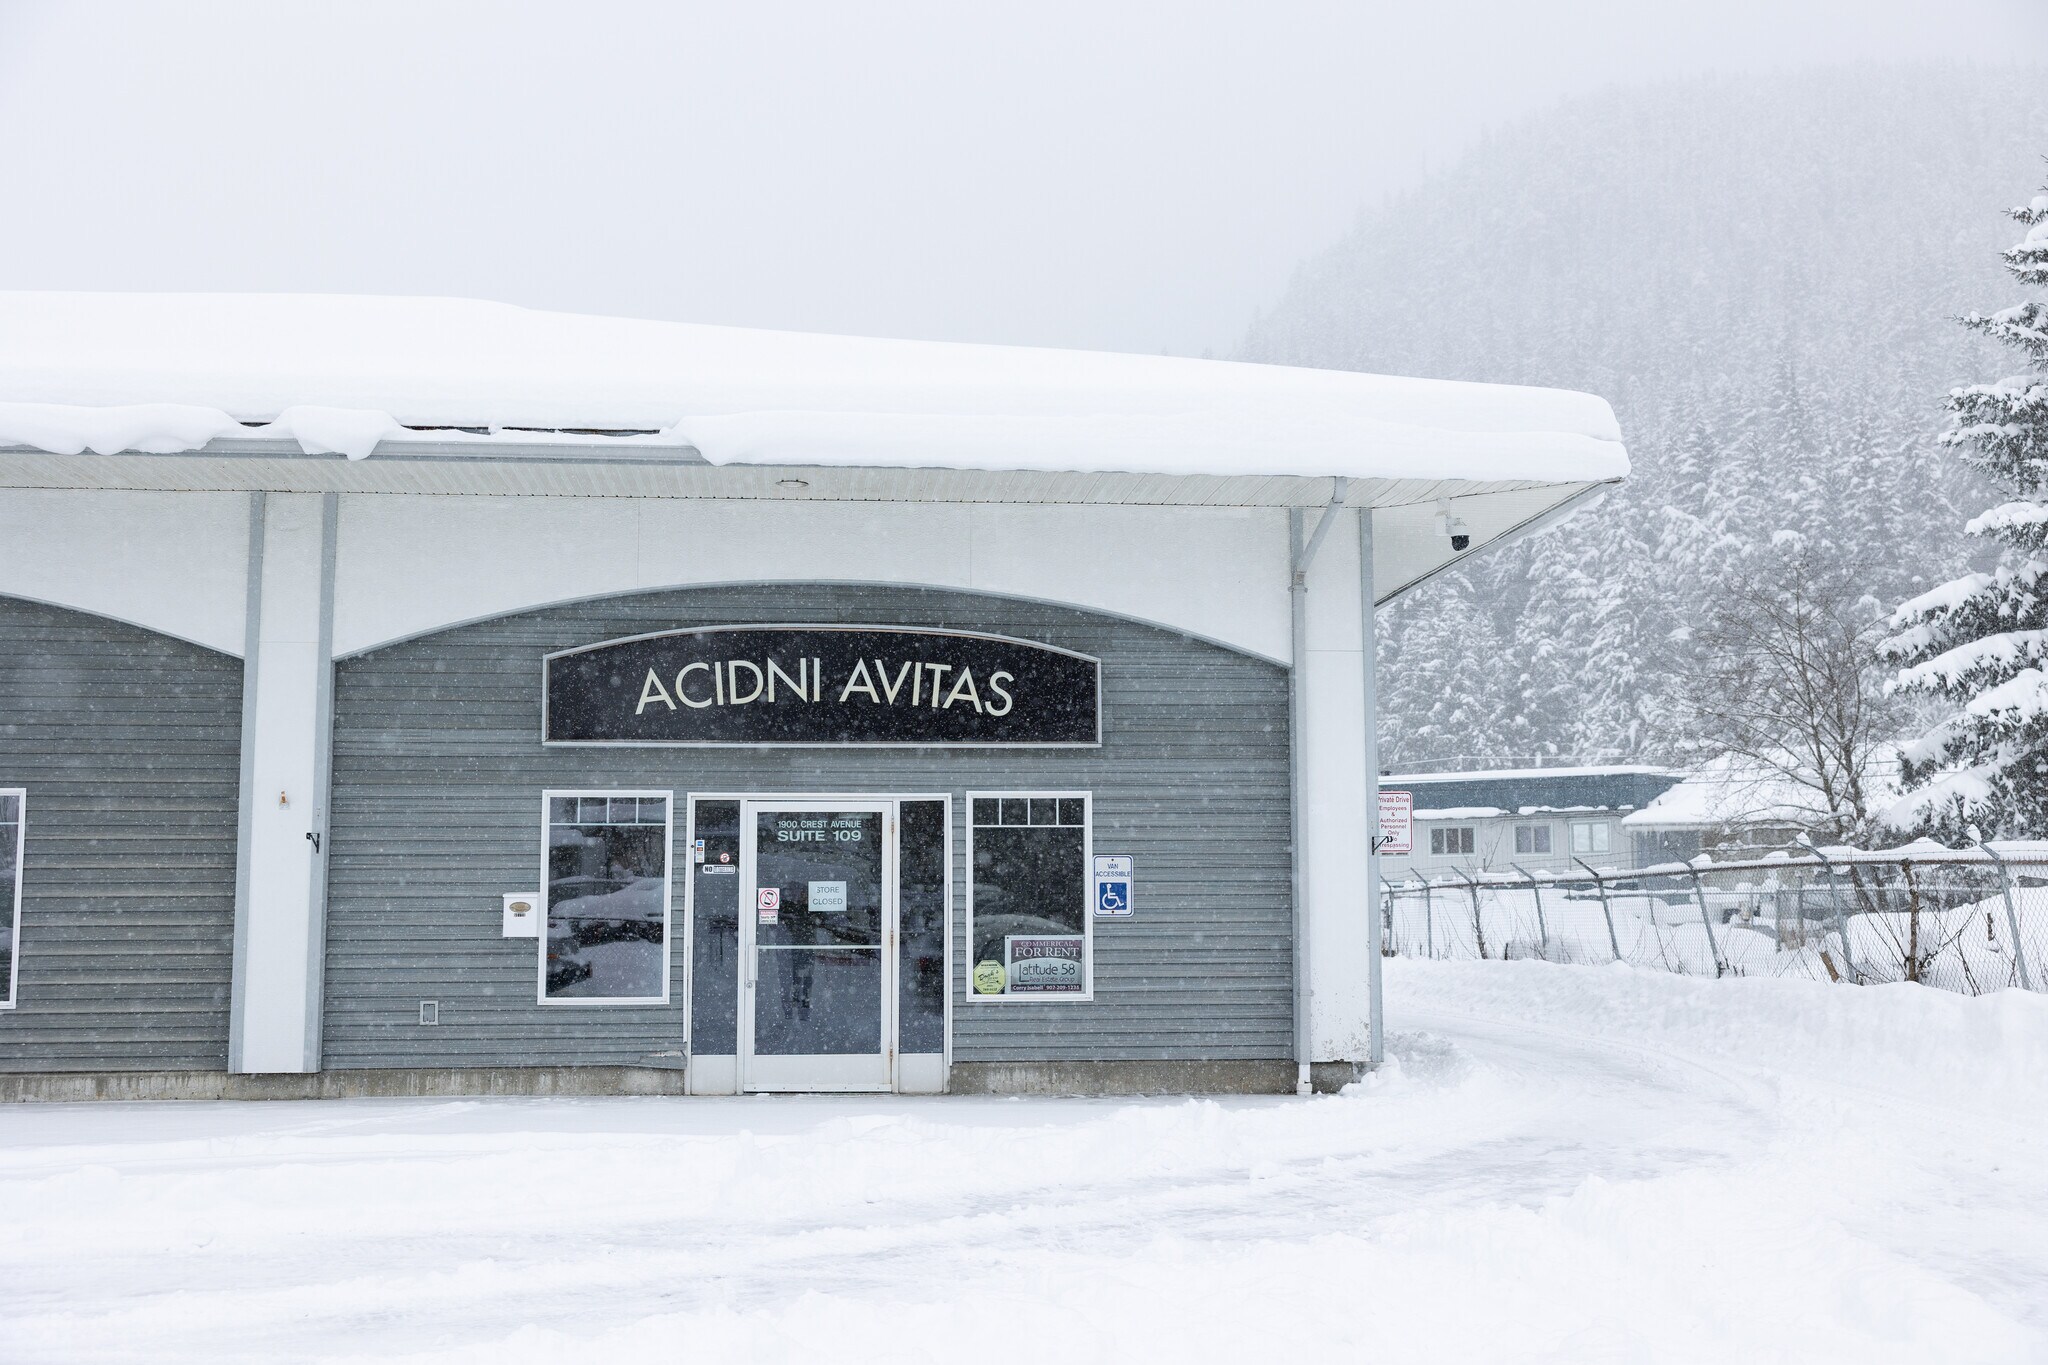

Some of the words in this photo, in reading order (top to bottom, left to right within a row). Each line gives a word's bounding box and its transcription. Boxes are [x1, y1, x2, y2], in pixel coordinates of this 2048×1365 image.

[635, 657, 820, 715] ACIDNI
[839, 657, 1015, 717] AVITAS
[778, 820, 798, 829] 1900
[801, 820, 828, 829] CREST
[831, 820, 862, 829] AVENUE
[777, 830, 826, 842] SUITE
[833, 830, 862, 842] 109
[817, 886, 840, 894] STORE
[1015, 947, 1042, 957] FOR
[1045, 947, 1079, 957] RENT
[1019, 963, 1058, 983] Latitude
[1061, 963, 1076, 976] 58
